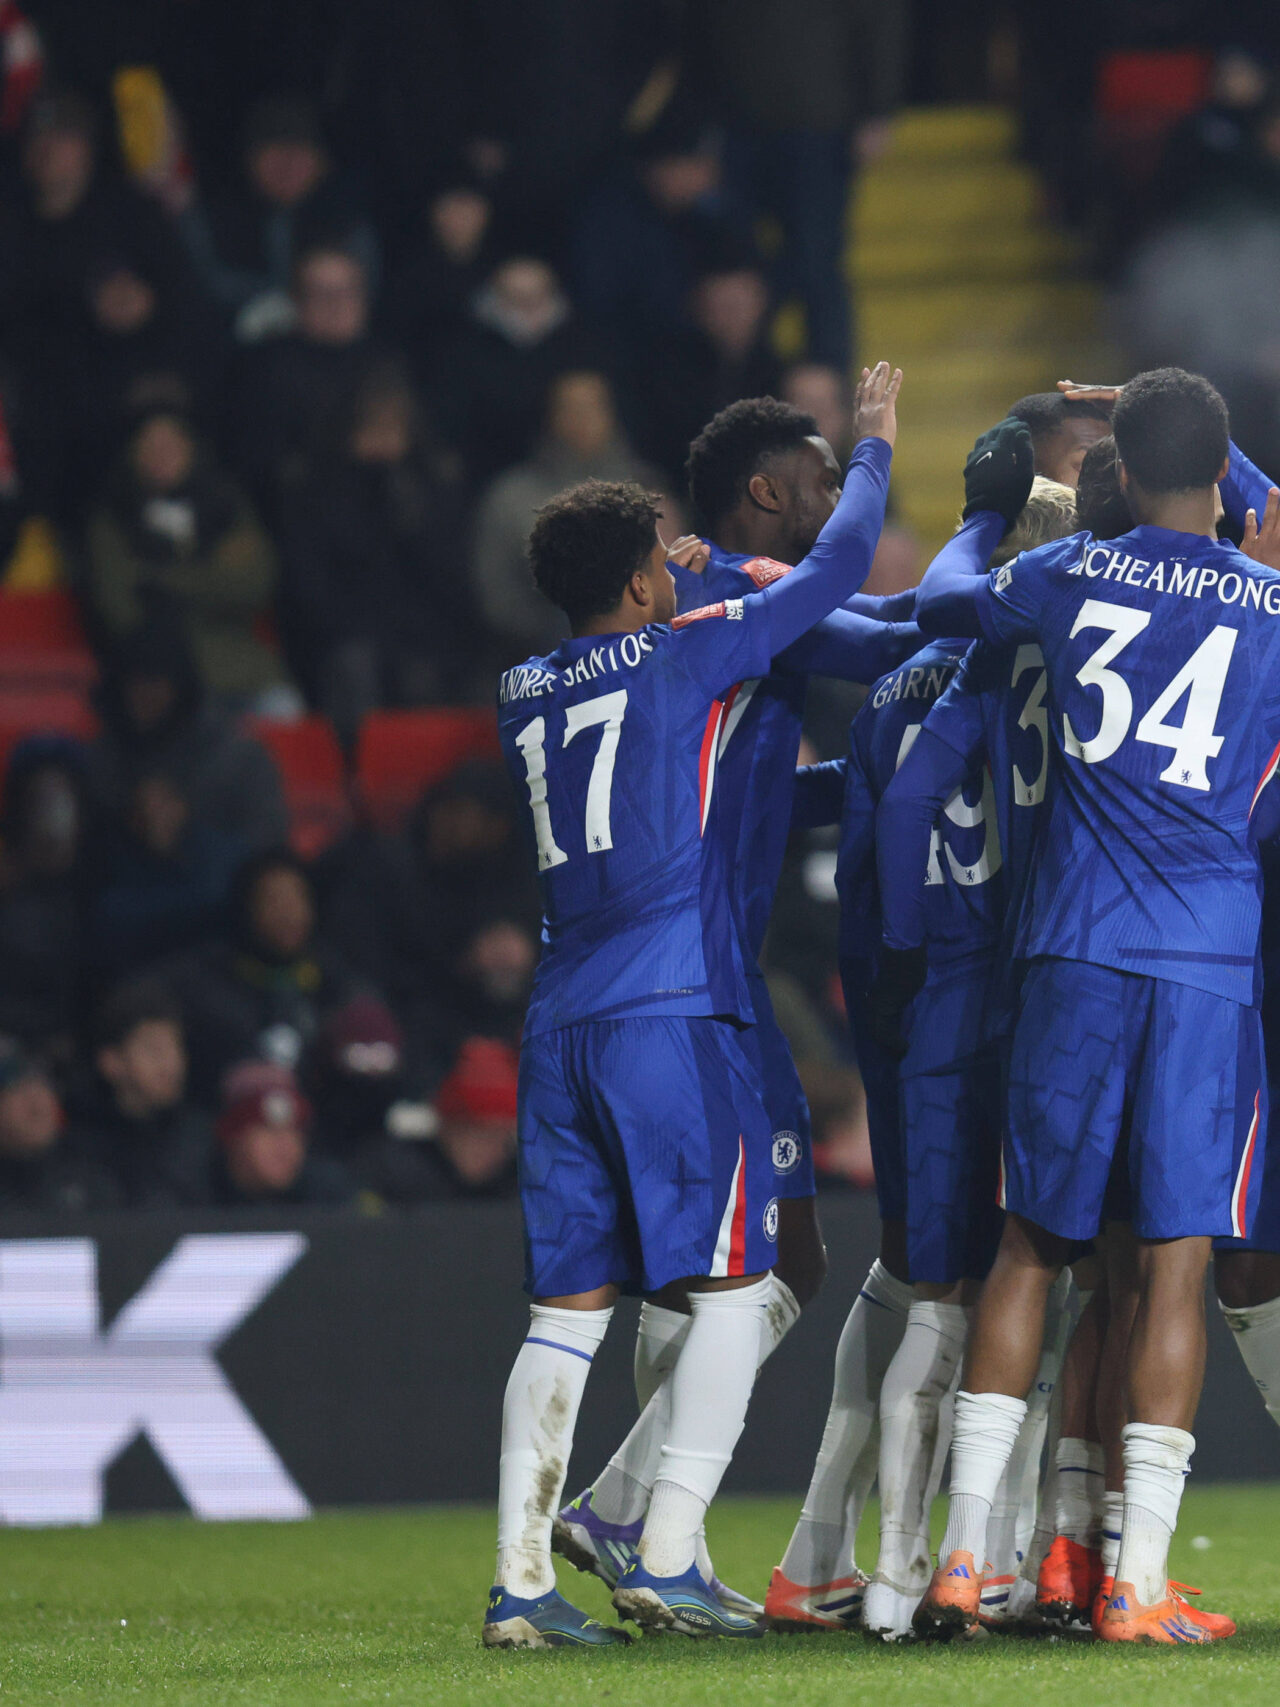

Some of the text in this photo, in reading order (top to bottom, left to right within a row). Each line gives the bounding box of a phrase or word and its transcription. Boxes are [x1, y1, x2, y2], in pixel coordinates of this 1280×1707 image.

[872, 667, 960, 710] GARN
[1063, 598, 1238, 791] 34
[514, 689, 628, 872] 17
[680, 1610, 712, 1627] MESSI
